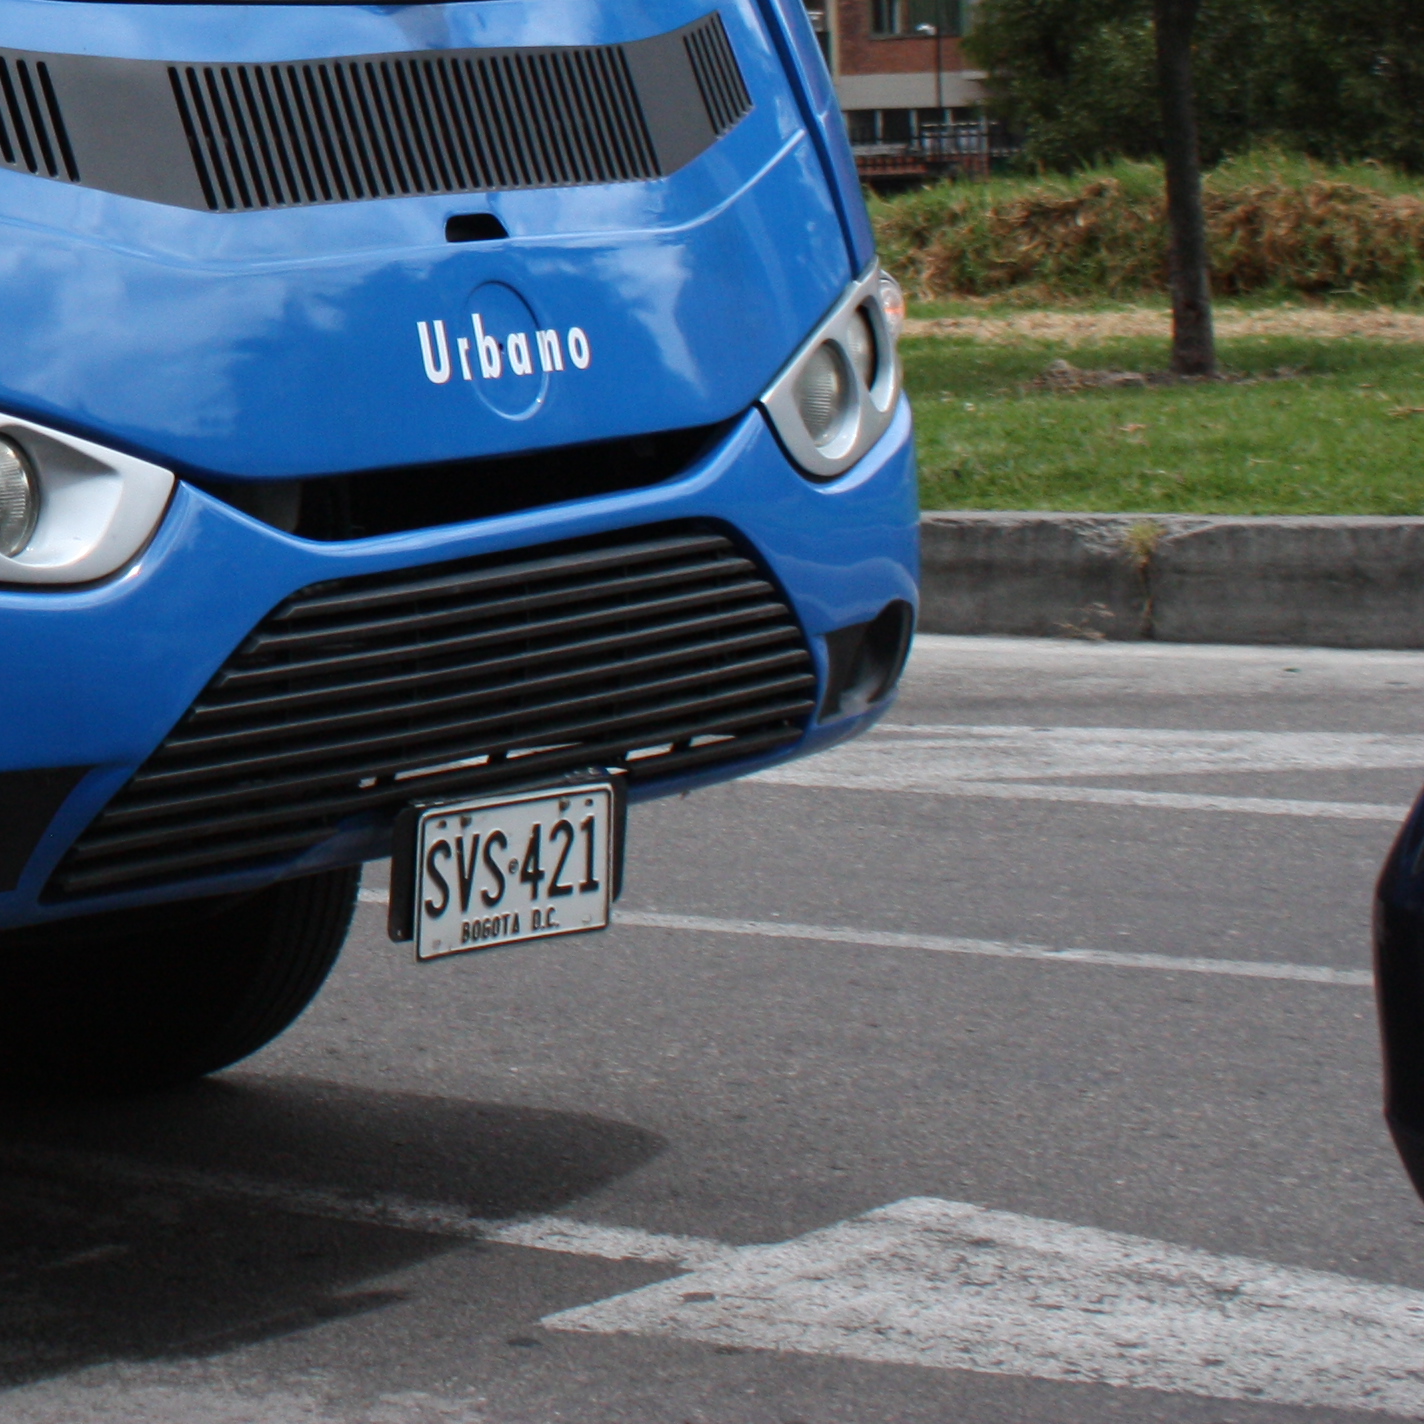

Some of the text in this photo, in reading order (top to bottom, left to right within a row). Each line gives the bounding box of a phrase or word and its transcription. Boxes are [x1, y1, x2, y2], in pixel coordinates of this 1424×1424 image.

[416, 313, 592, 385] Urbano
[461, 906, 561, 944] BOGOTA D.C.
